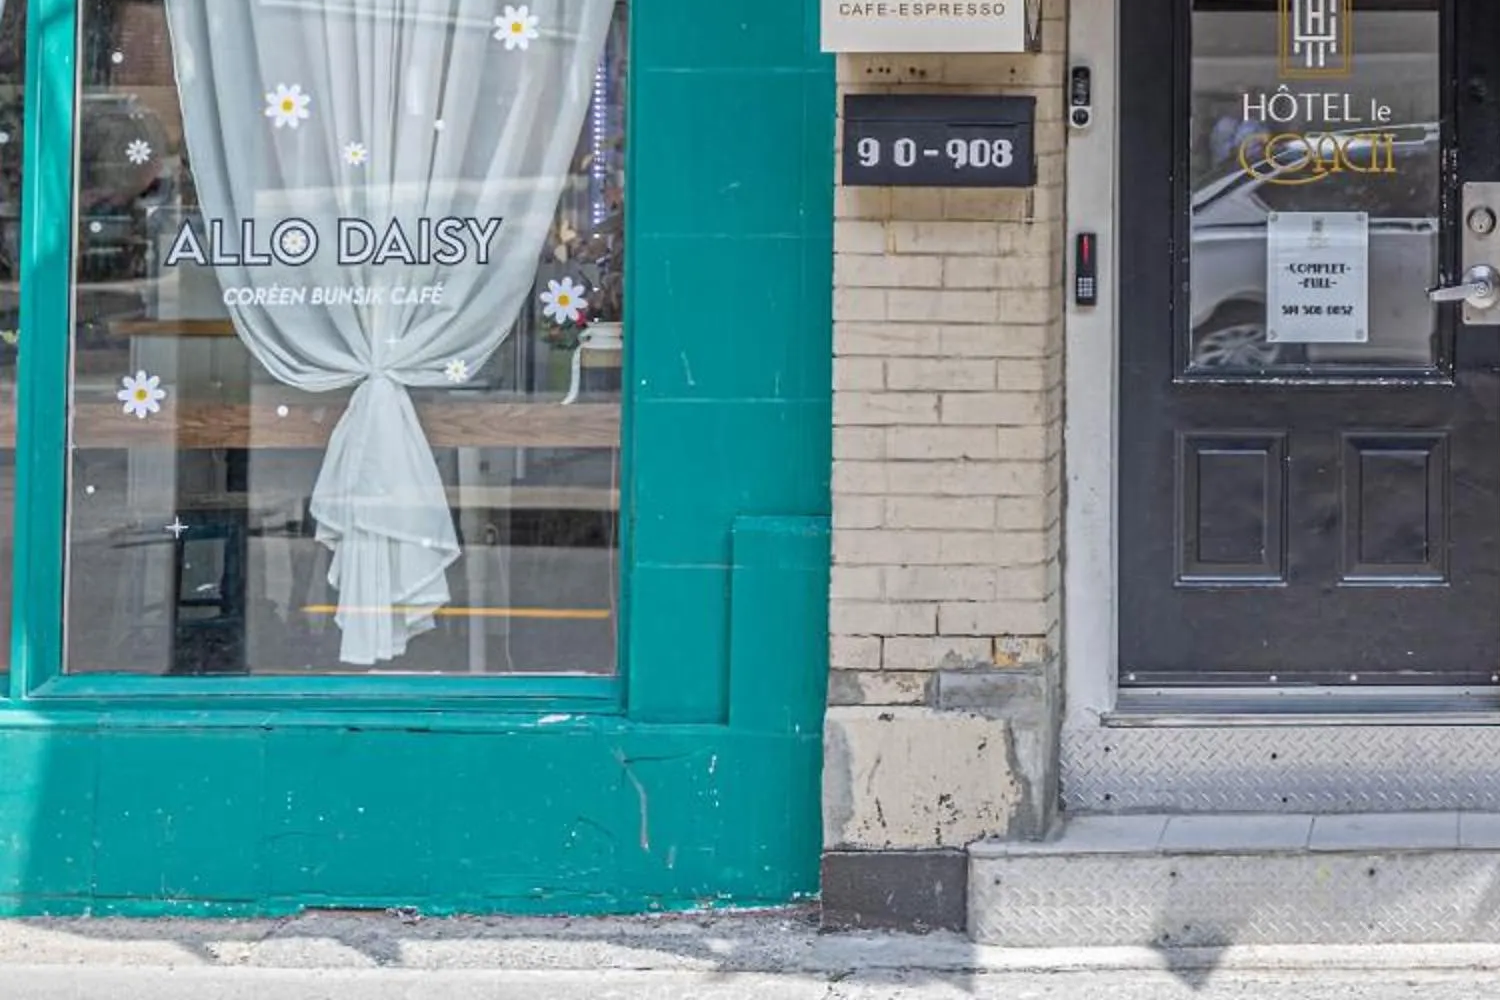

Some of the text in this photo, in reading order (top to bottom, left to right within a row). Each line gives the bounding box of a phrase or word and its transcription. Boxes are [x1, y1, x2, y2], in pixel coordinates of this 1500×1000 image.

[838, 2, 1006, 17] CAFE-ESPRESSO
[1243, 84, 1392, 122] HÔTEL le
[1239, 132, 1397, 185] COACH
[164, 216, 503, 267] ALLO DAISY
[223, 281, 445, 306] CORÉEN BUNSIK CAFÉ
